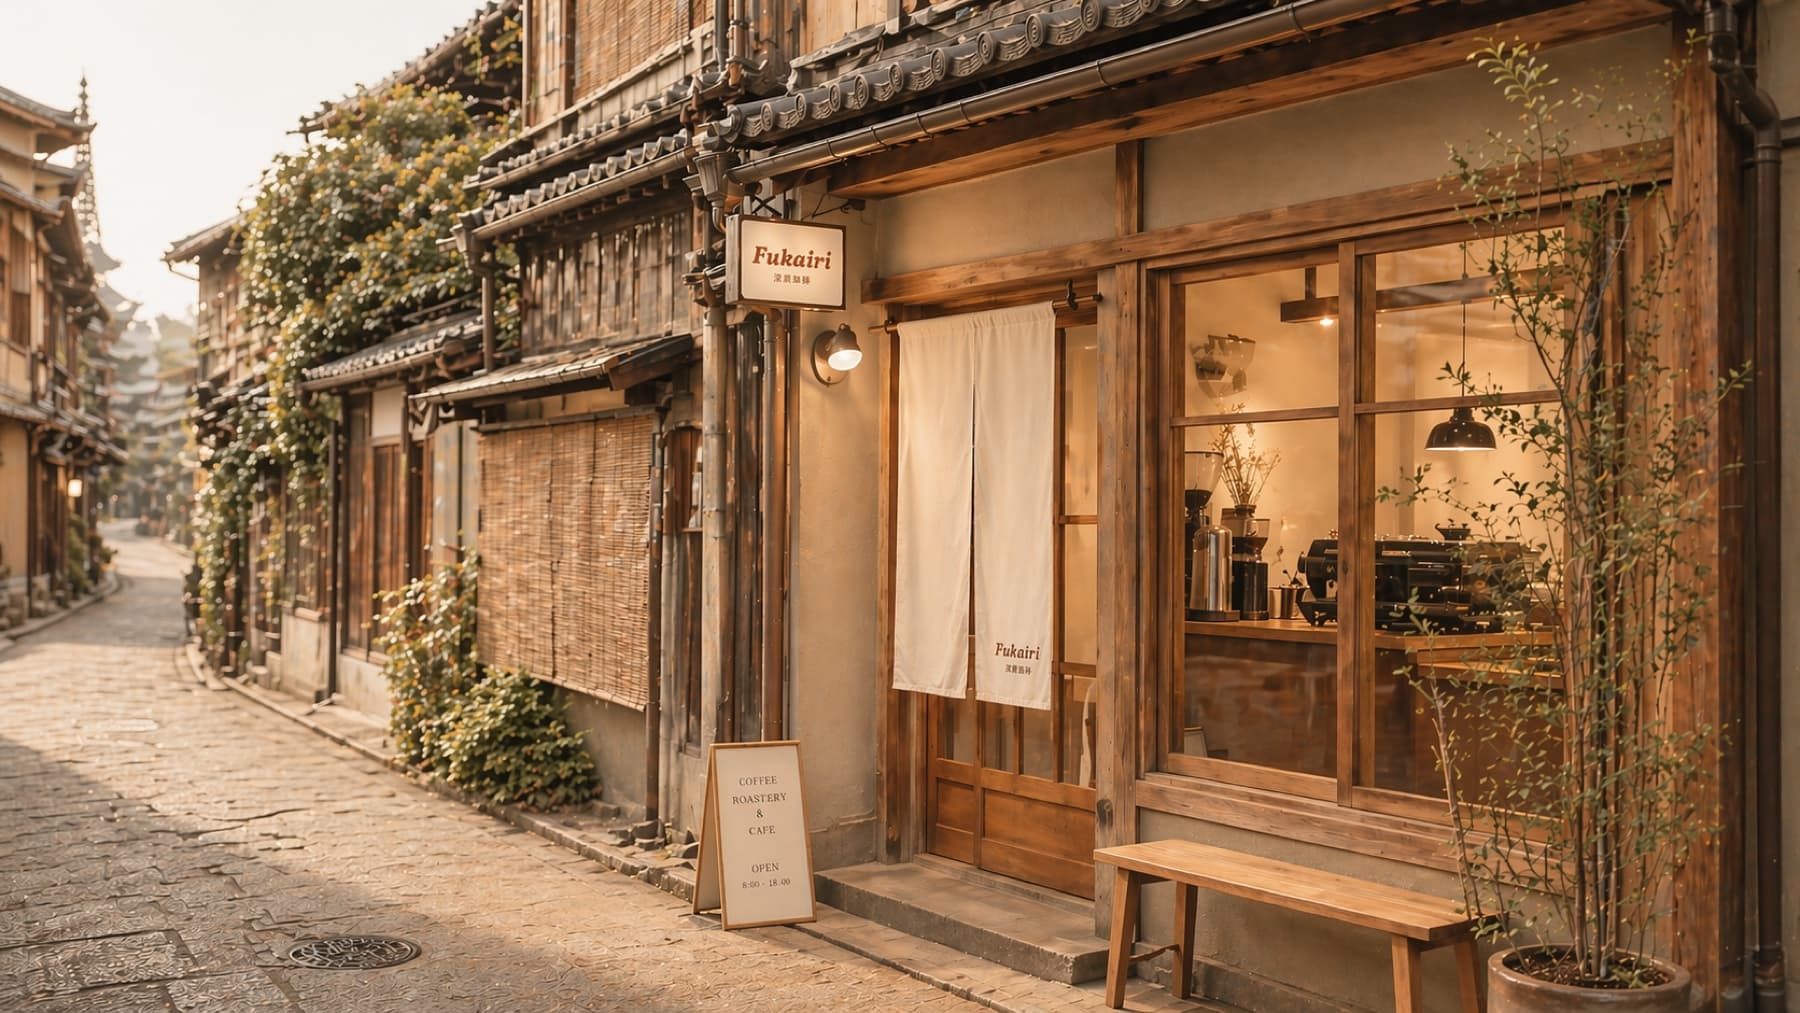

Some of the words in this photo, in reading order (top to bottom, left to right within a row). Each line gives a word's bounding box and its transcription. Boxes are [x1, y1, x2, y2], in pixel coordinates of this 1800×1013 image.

[752, 245, 831, 270] Fukairi
[995, 642, 1040, 660] Fukairi
[739, 775, 777, 786] COFFEE
[732, 792, 787, 805] ROASTERY
[756, 808, 764, 818] &
[748, 825, 776, 835] CAFE
[751, 862, 780, 873] OPEN
